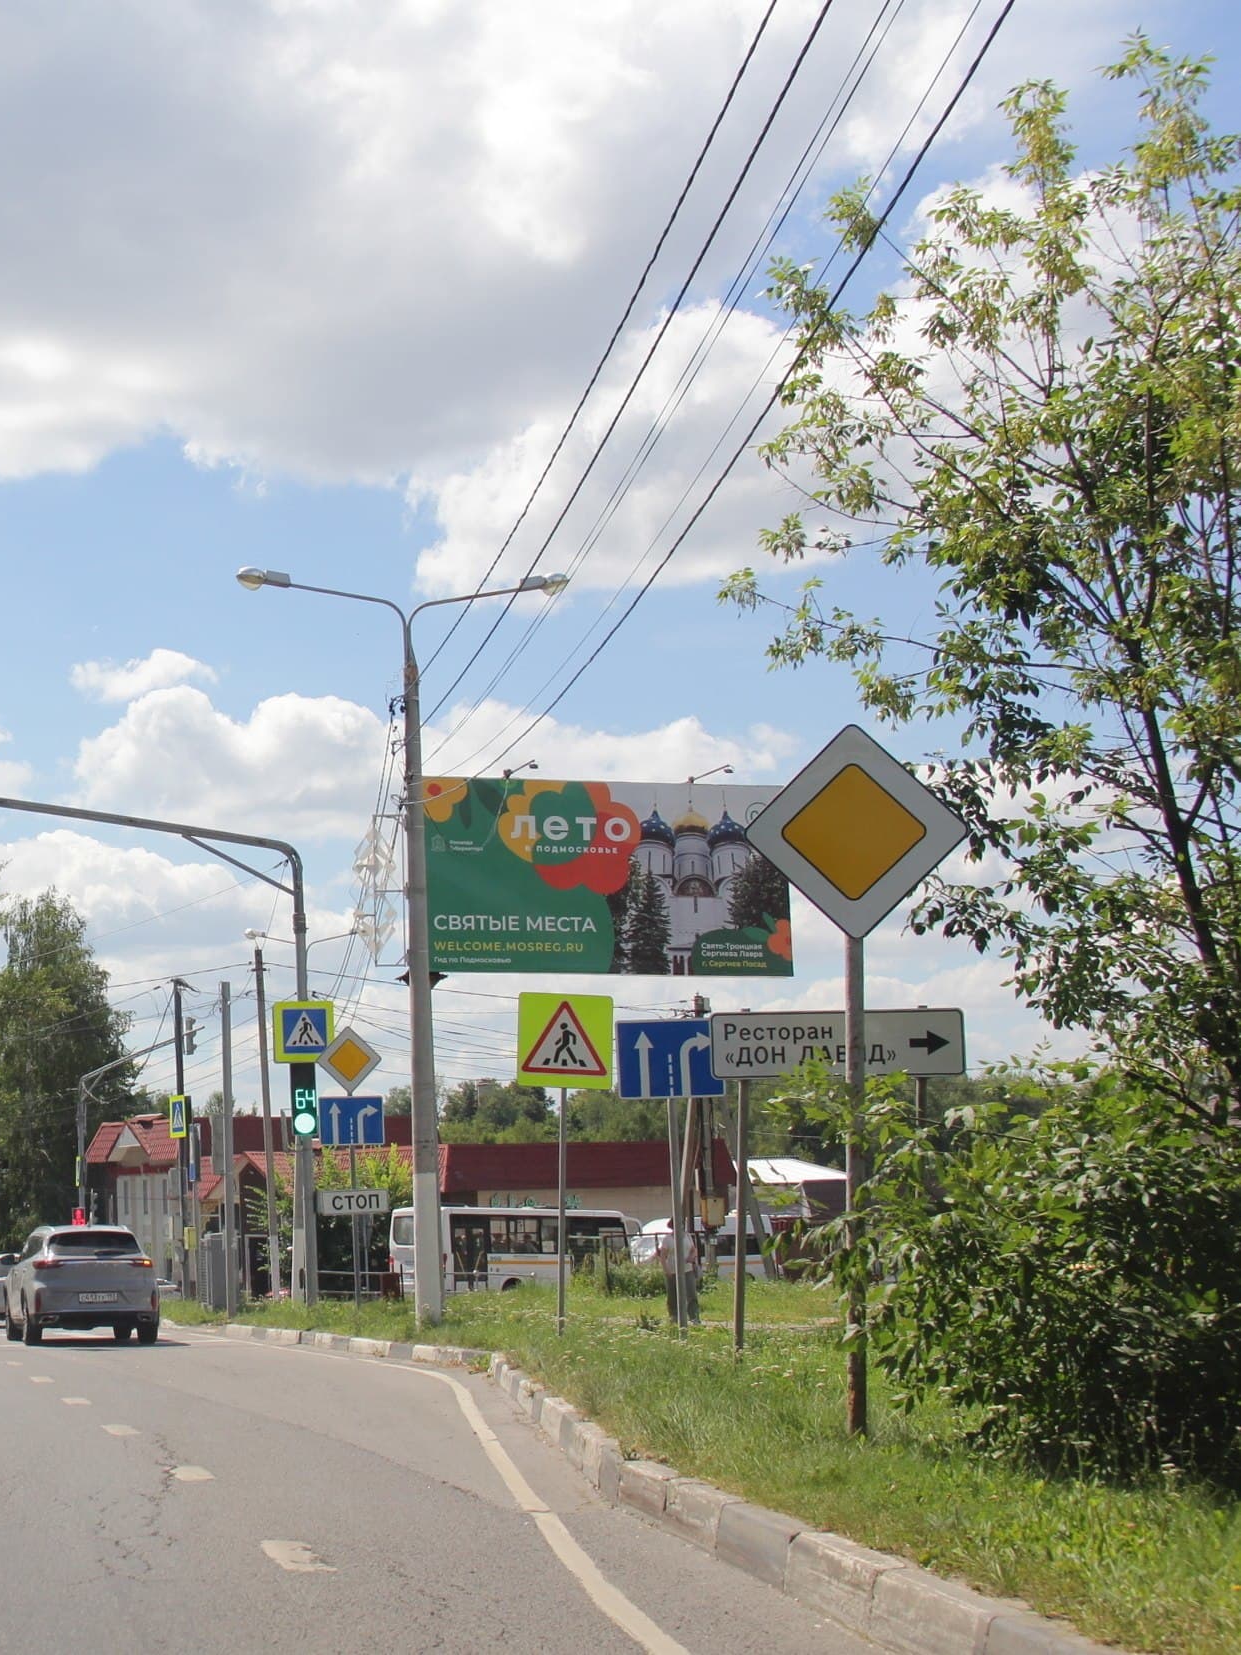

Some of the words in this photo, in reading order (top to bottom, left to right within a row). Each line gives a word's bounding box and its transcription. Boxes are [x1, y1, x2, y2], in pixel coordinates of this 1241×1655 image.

[511, 815, 631, 842] лето
[434, 915, 520, 932] СВЯТЫЕ
[526, 916, 597, 933] МЕСТА
[434, 941, 584, 952] WELCOME.MOSREG.RU
[724, 1023, 833, 1044] Ресторан
[295, 1089, 316, 1109] 64
[332, 1194, 380, 1210] СТОП
